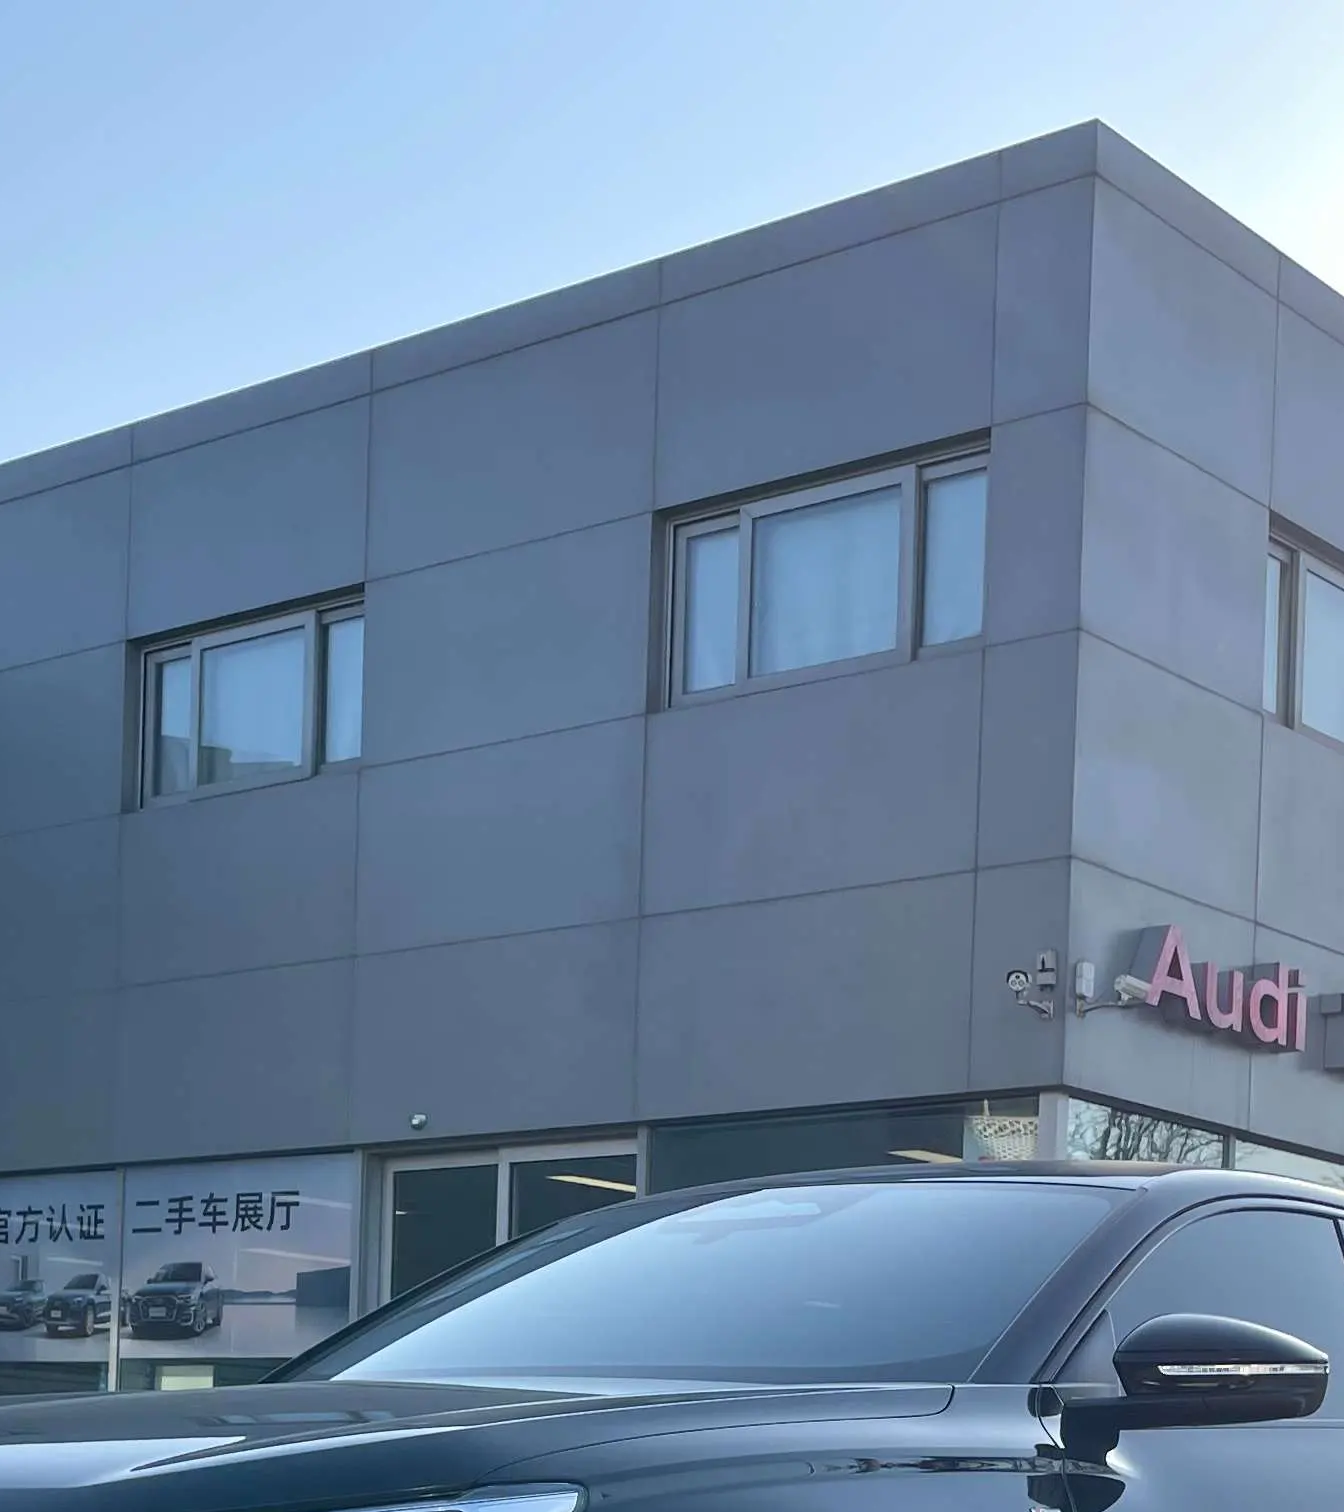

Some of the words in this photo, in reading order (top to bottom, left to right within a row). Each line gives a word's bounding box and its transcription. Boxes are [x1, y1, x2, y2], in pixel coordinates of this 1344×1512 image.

[1147, 924, 1307, 1052] Audi
[132, 1190, 299, 1235] 二手车展厅
